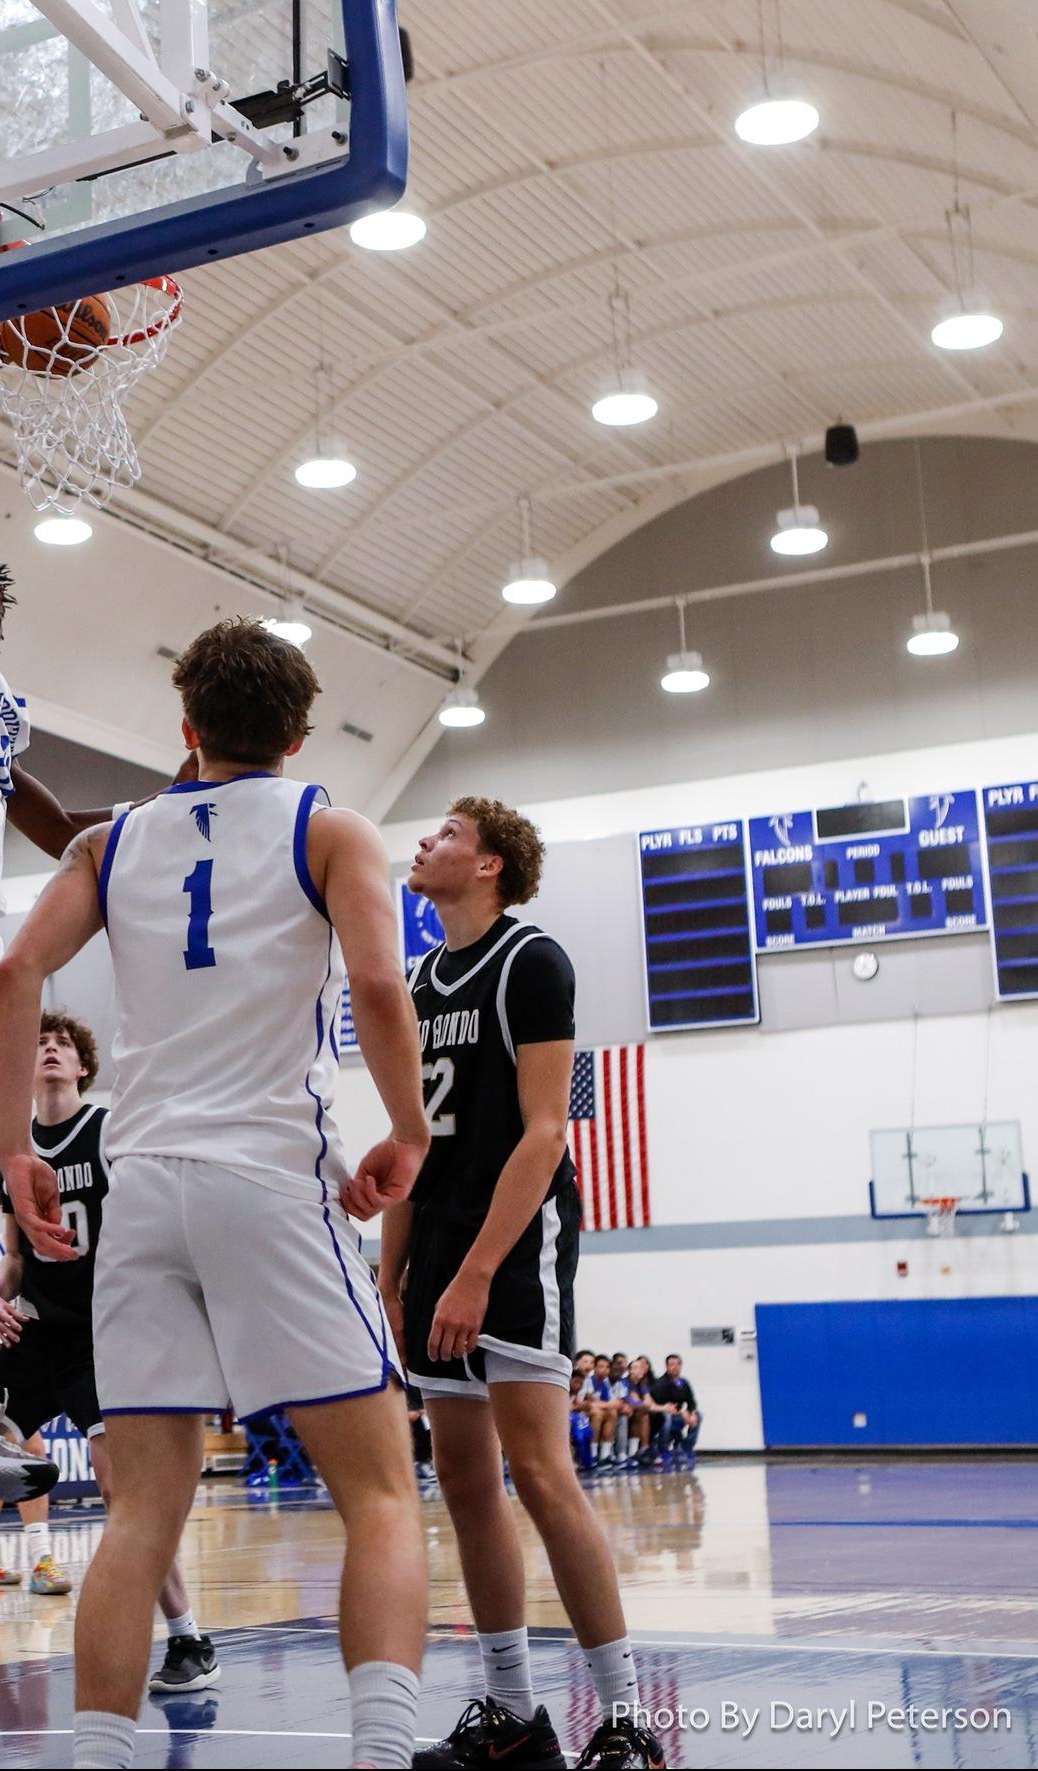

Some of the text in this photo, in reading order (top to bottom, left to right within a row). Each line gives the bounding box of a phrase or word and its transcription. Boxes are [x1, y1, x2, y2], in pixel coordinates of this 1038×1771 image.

[642, 823, 737, 851] PLYR FLS PTS
[919, 825, 965, 848] GUEST
[755, 844, 813, 867] FALCONS
[846, 844, 880, 860] PERIOD
[834, 884, 898, 904] PLAYER FOUL
[941, 875, 974, 892] FOULS
[182, 858, 217, 971] 1
[763, 895, 792, 911] FOULS
[57, 1162, 93, 1193] ONDO
